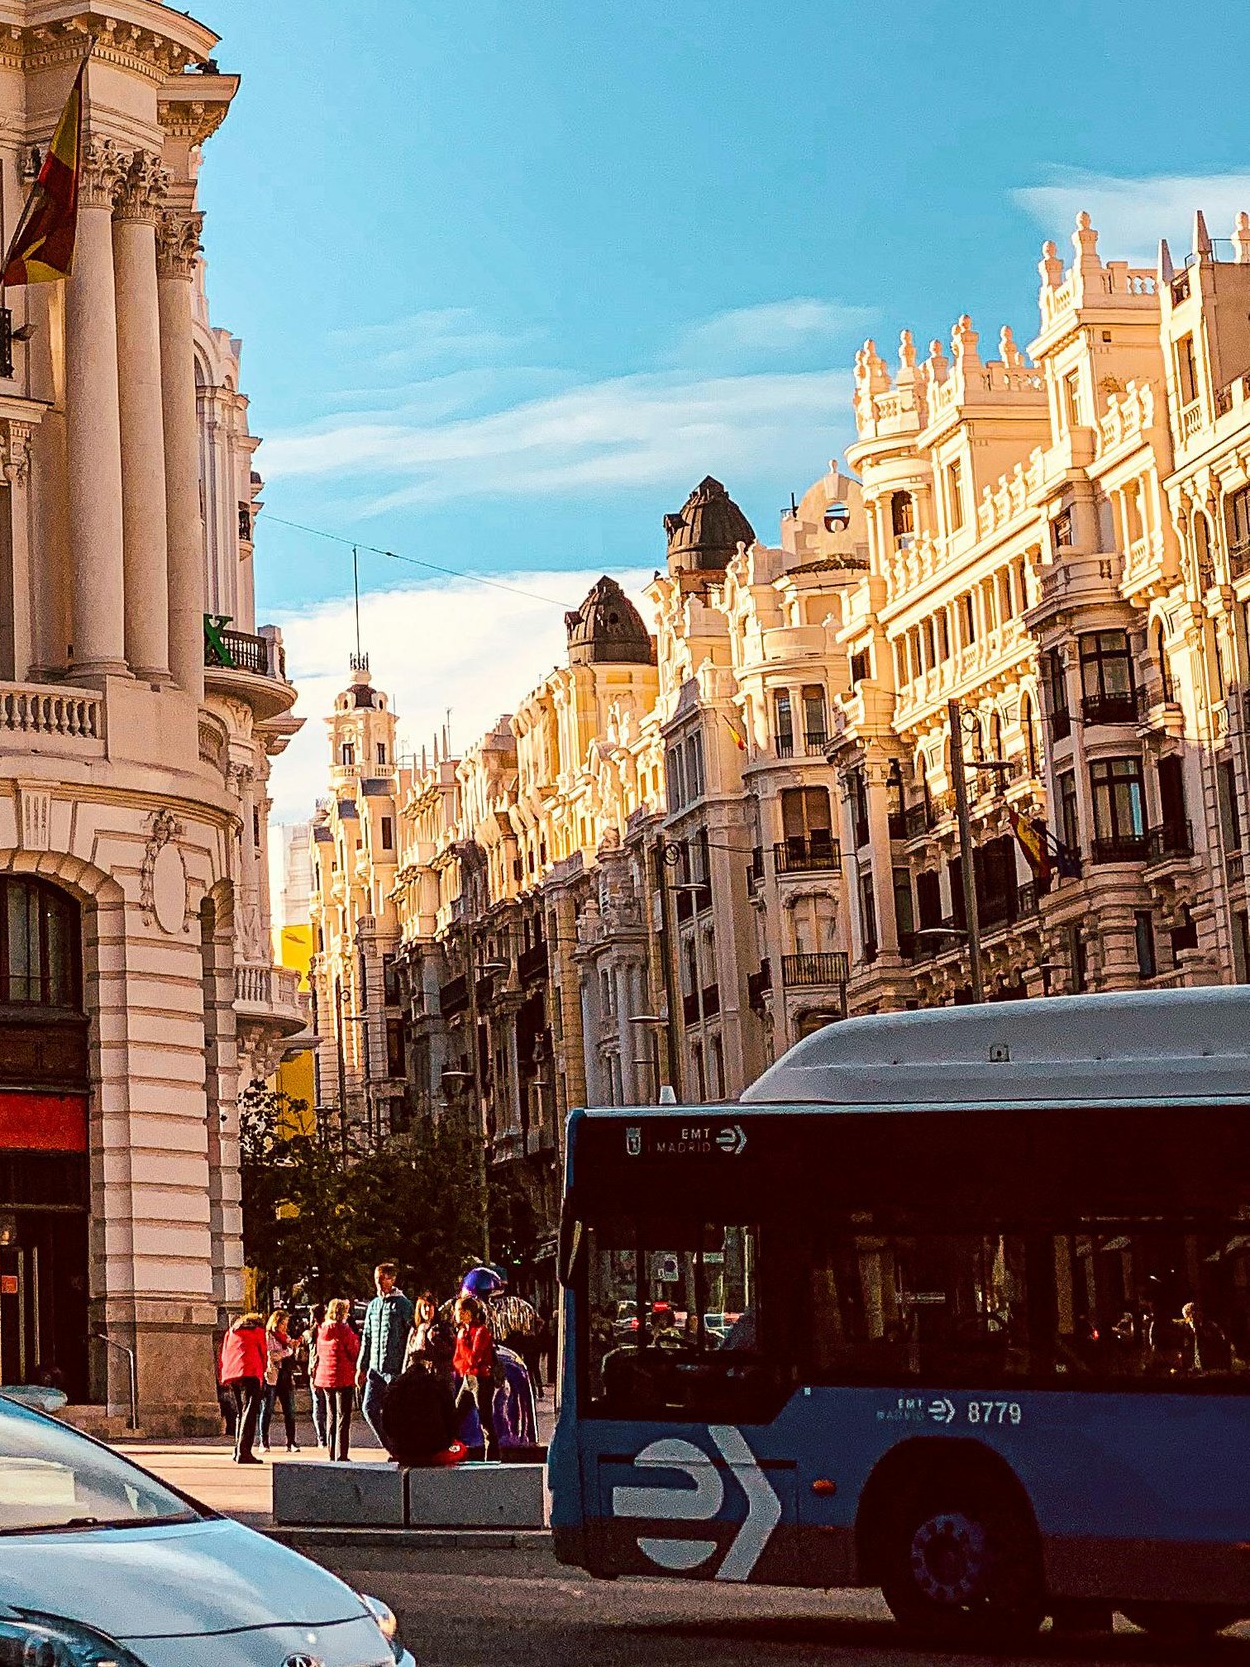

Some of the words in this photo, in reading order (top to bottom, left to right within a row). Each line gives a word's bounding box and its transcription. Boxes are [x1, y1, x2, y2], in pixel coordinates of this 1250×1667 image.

[681, 1128, 711, 1139] EMT
[656, 1141, 711, 1153] MADRID
[968, 1401, 1021, 1424] 8779
